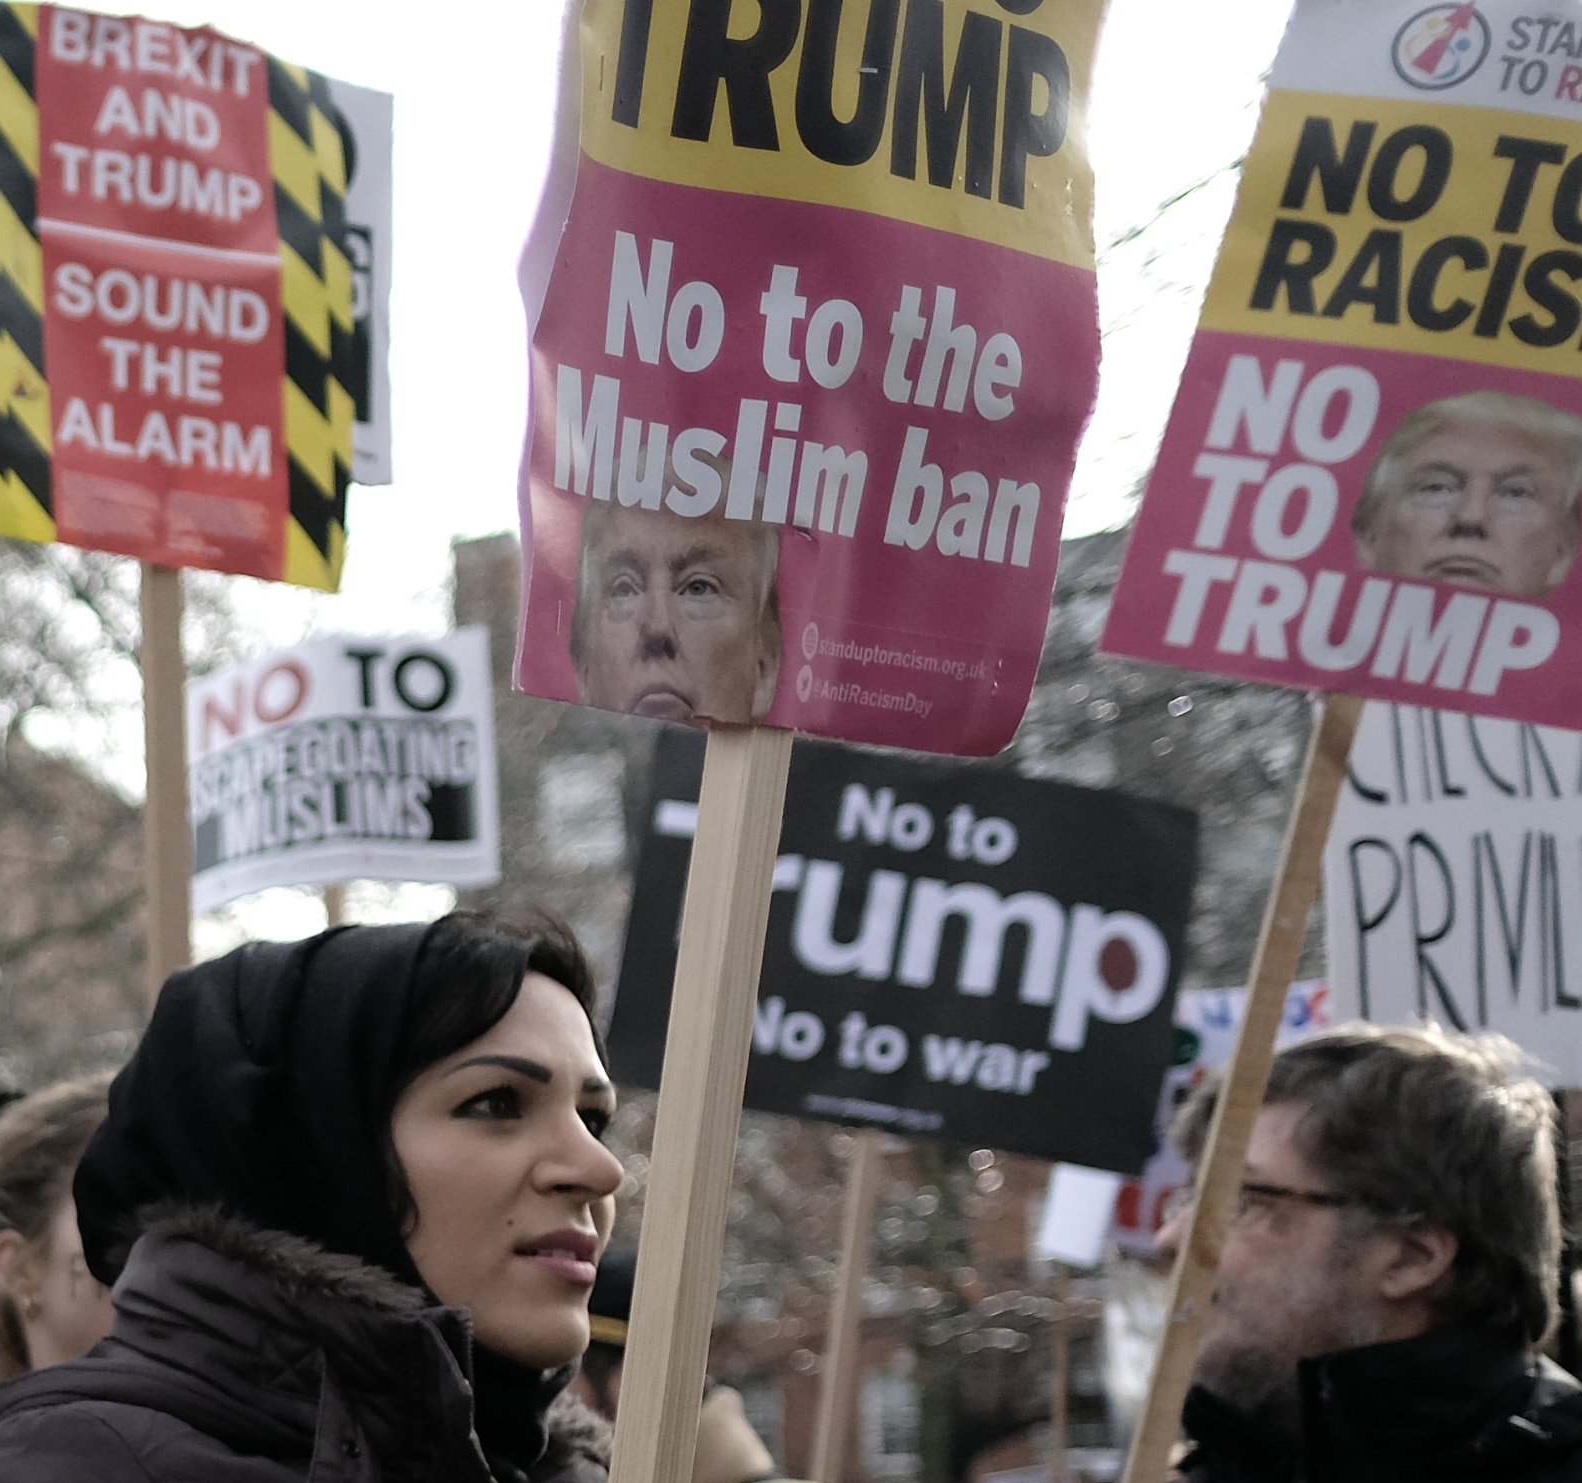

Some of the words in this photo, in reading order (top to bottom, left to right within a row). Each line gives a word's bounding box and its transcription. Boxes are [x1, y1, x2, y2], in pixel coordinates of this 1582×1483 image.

[50, 10, 261, 97] BREXIT
[1501, 55, 1549, 95] TO
[1506, 15, 1582, 58] STA
[96, 86, 221, 151] AND
[50, 143, 263, 223] TRUMP
[1280, 116, 1453, 223] NO
[55, 263, 270, 342] SOUND
[605, 230, 725, 373] No
[760, 264, 864, 390] to
[882, 283, 1023, 422] the
[1248, 218, 1582, 351] RACIS
[101, 338, 224, 404] THE
[1205, 353, 1382, 465] NO
[58, 398, 273, 478] ALARM
[554, 363, 868, 540] Muslim
[883, 425, 1041, 568] ban
[1193, 453, 1340, 561] TO
[819, 637, 987, 682] standuptoracism.org.uk
[1162, 549, 1561, 698] TRUMP
[200, 658, 311, 751] NO
[344, 646, 457, 713] TO
[219, 776, 435, 860] MUSLIMS
[838, 781, 935, 853] No
[946, 802, 1019, 867] to
[653, 799, 1171, 1052] ump
[1348, 829, 1582, 1034] PRIVIL
[752, 995, 826, 1062] No
[838, 1009, 910, 1075] to
[922, 1032, 1051, 1096] war
